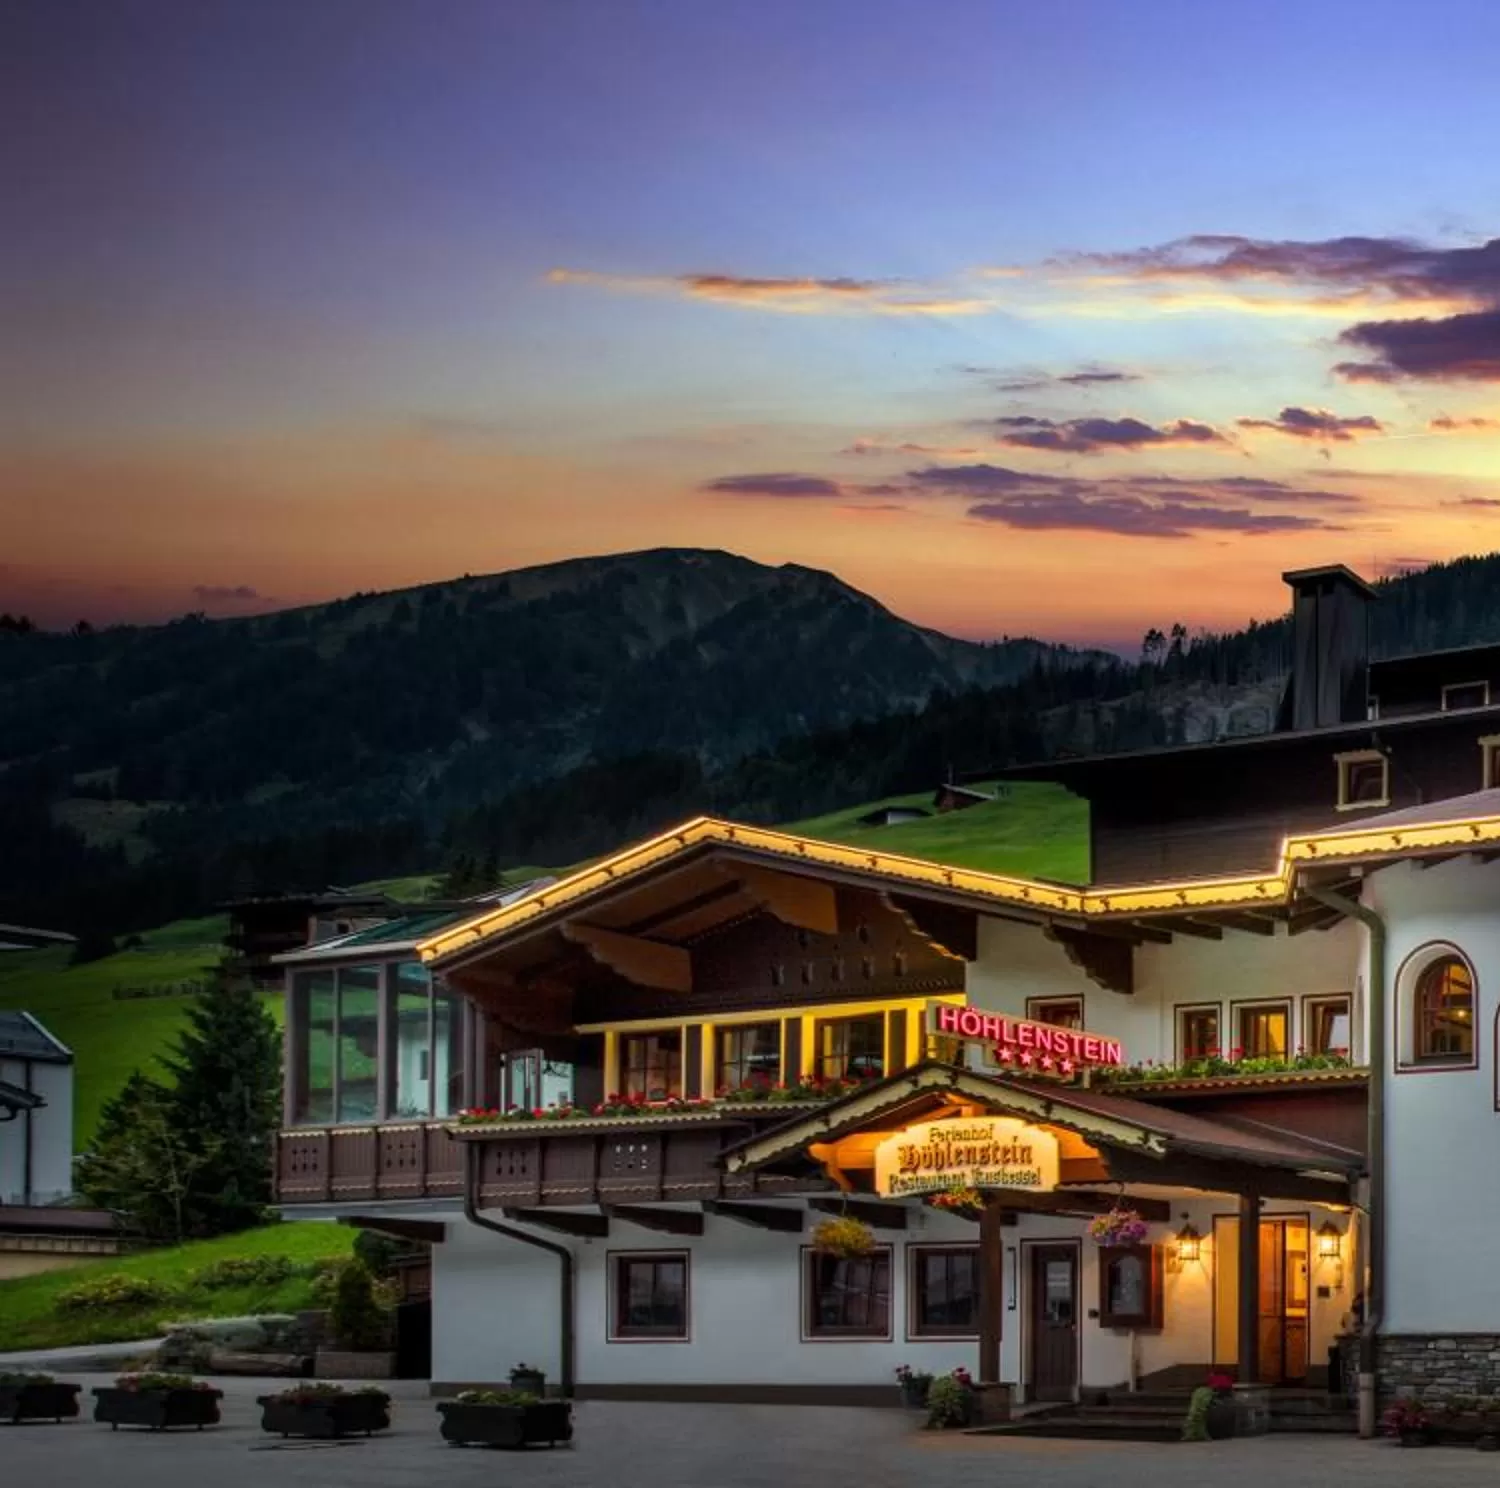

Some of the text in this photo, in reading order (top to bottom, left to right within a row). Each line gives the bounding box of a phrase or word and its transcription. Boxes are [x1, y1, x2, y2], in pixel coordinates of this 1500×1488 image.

[940, 1004, 1121, 1064] HÖHLENSTEIN
[929, 1123, 995, 1142] Ferienhof
[898, 1136, 1033, 1174] Höhlenstein
